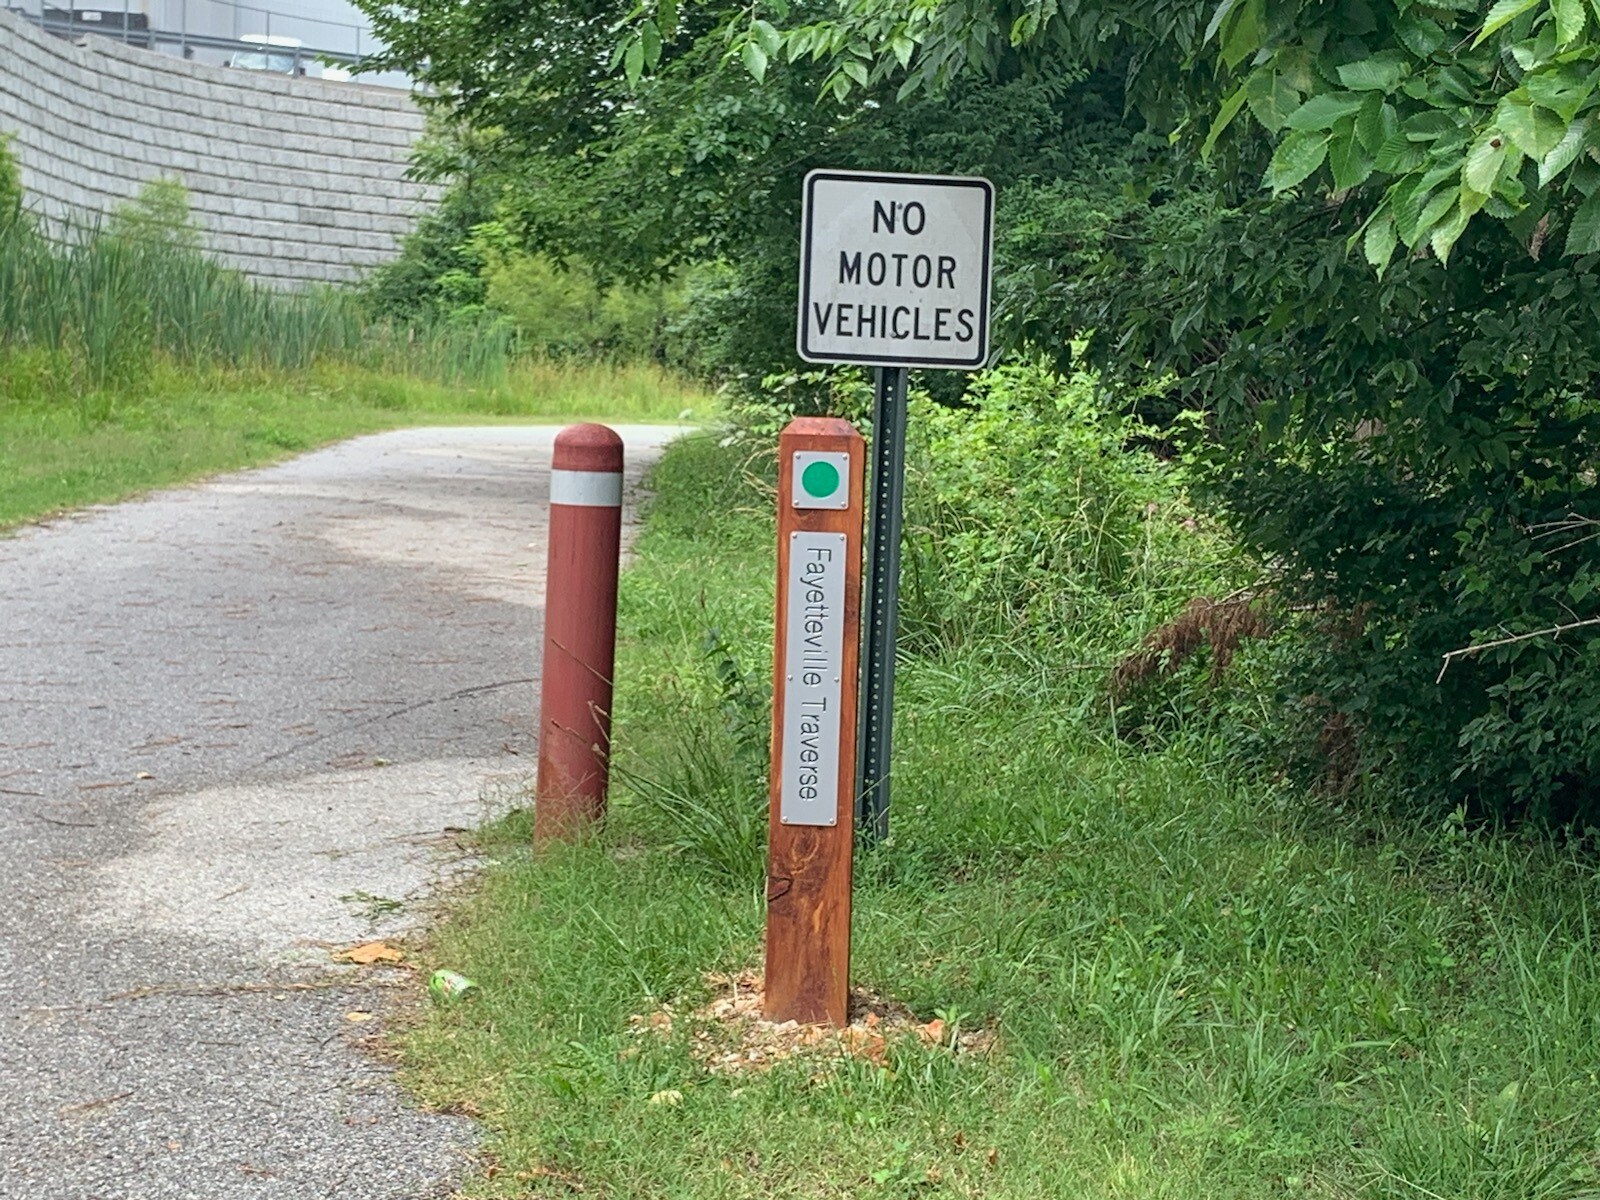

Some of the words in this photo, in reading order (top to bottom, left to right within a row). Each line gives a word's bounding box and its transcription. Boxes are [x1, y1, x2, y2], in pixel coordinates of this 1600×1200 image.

[873, 200, 926, 235] NO
[839, 251, 956, 289] MOTOR
[813, 302, 974, 342] VEHICLES
[800, 548, 832, 685] Fayetteville
[798, 697, 826, 800] Traverse
